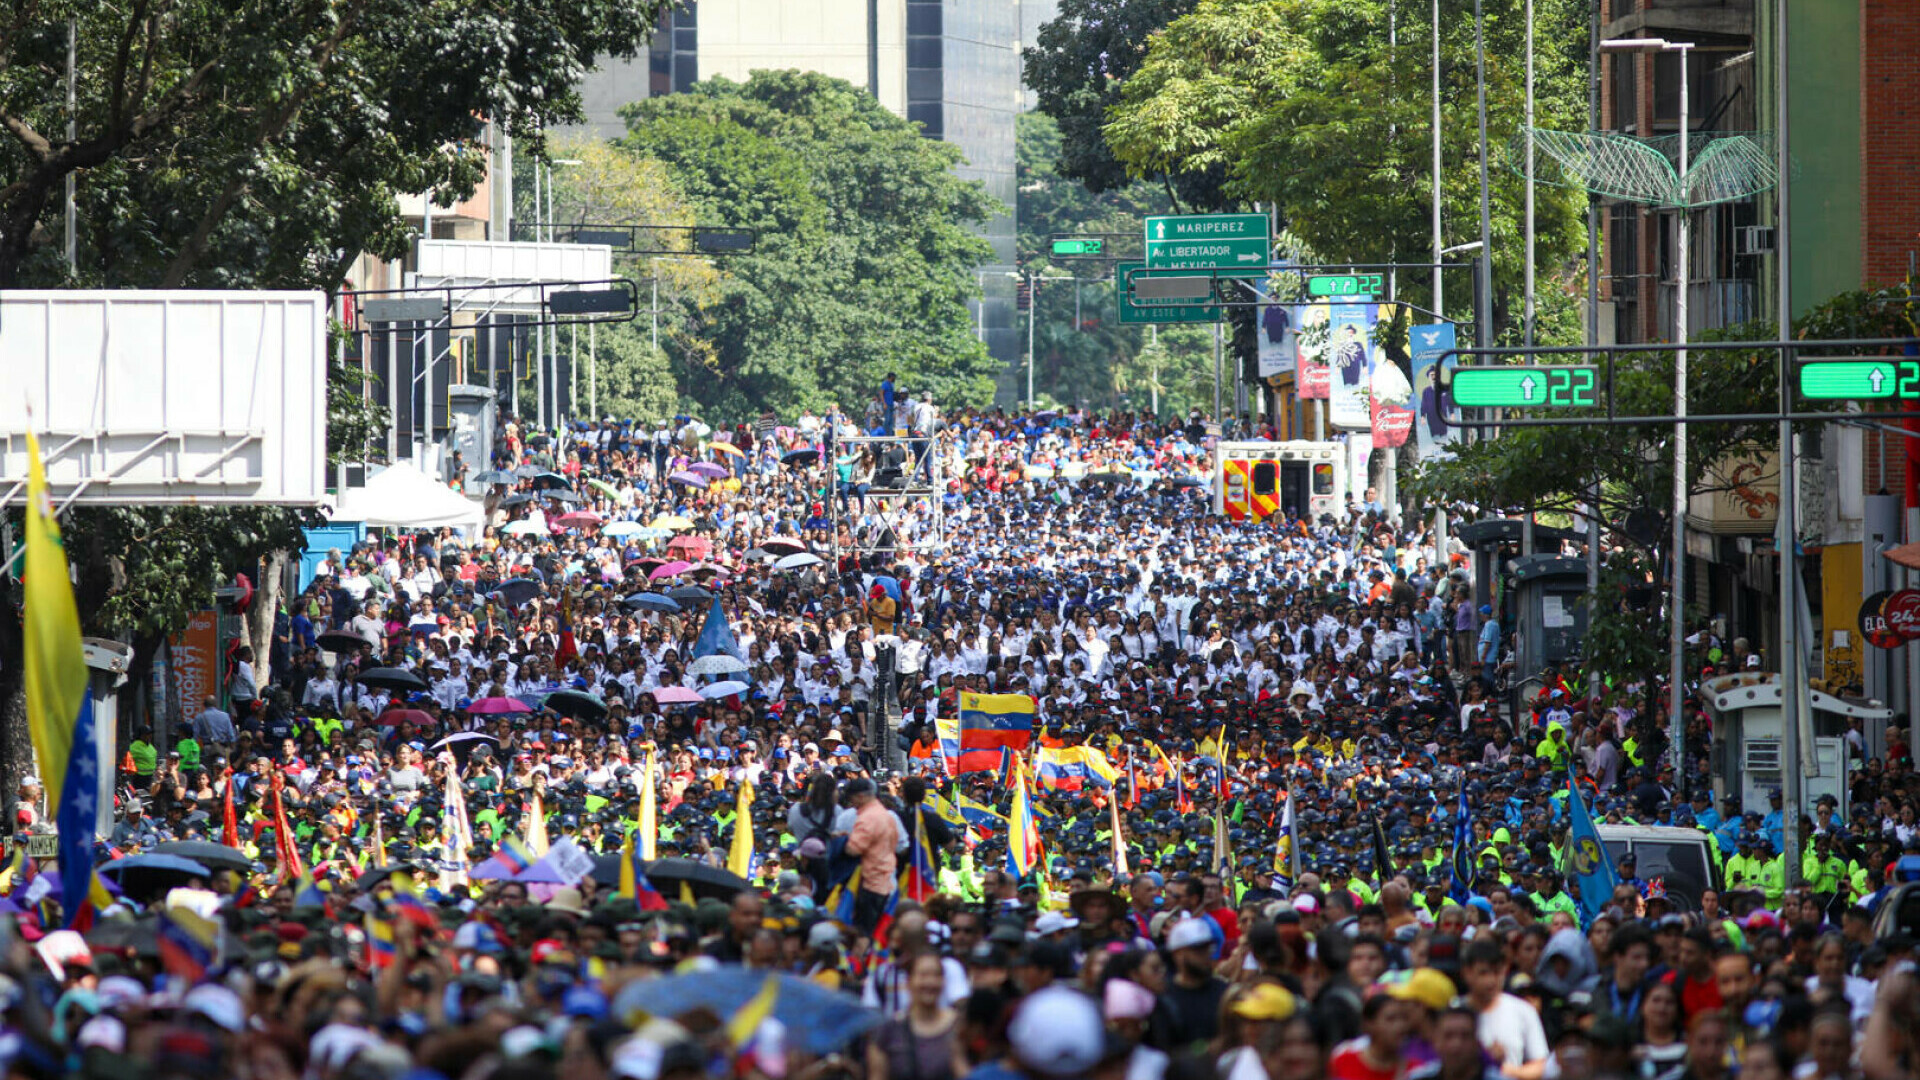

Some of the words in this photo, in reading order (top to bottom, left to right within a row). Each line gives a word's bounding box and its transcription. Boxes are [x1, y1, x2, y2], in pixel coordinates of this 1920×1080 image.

[1177, 222, 1244, 233] MARIPEREZ
[1085, 240, 1101, 254] 22
[1170, 246, 1231, 257] LIBERTADOR
[1359, 275, 1382, 295] 22
[1550, 369, 1594, 406] 22
[1898, 361, 1920, 398] 2
